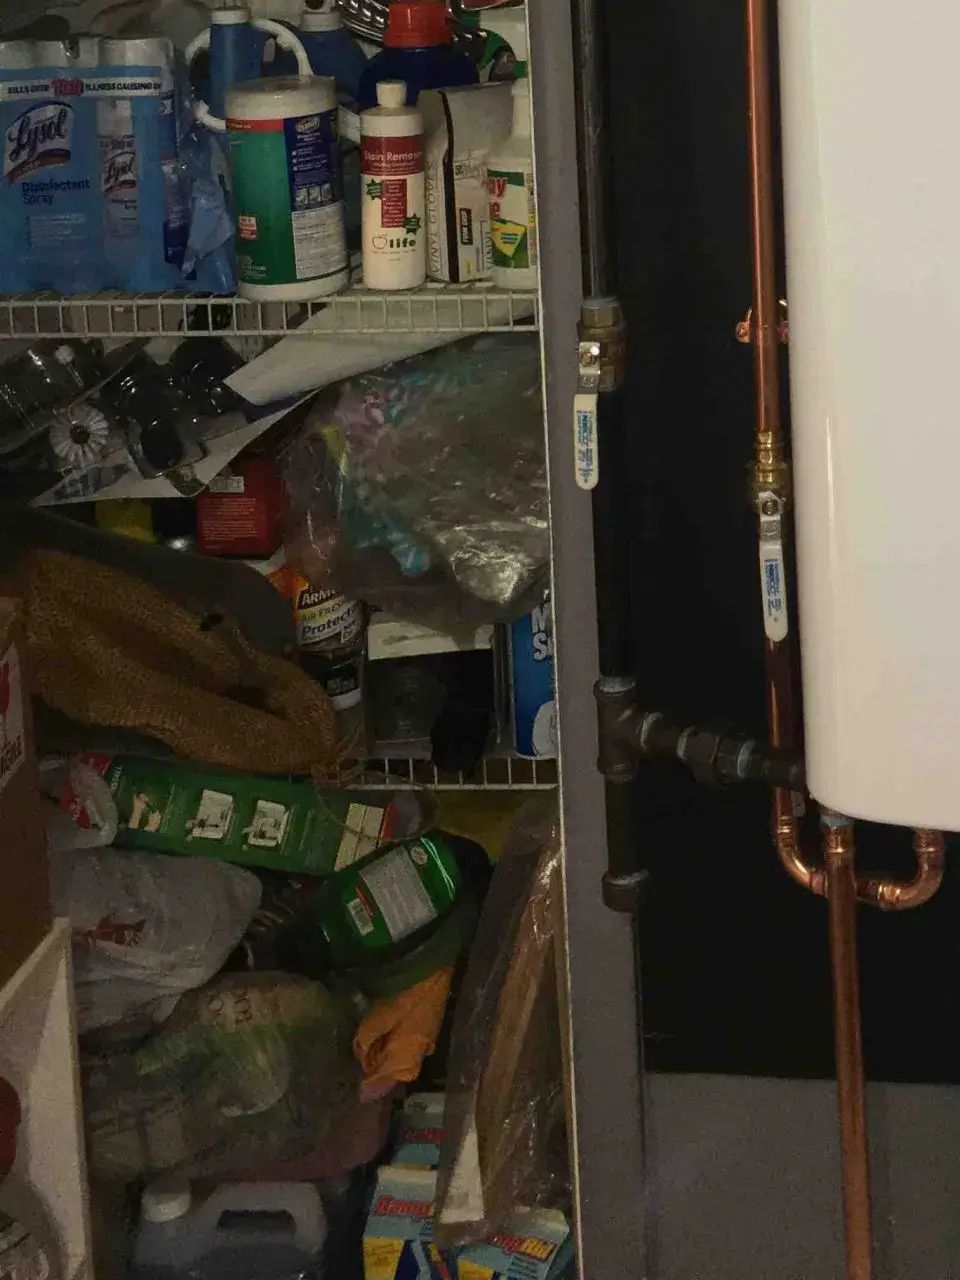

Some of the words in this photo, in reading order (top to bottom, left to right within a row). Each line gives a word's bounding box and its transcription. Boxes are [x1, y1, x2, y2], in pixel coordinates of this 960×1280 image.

[116, 81, 153, 91] CAUSING
[8, 107, 69, 164] Lysol
[105, 152, 136, 183] Lysol
[21, 179, 91, 192] Disinfectant
[22, 193, 54, 206] Spray
